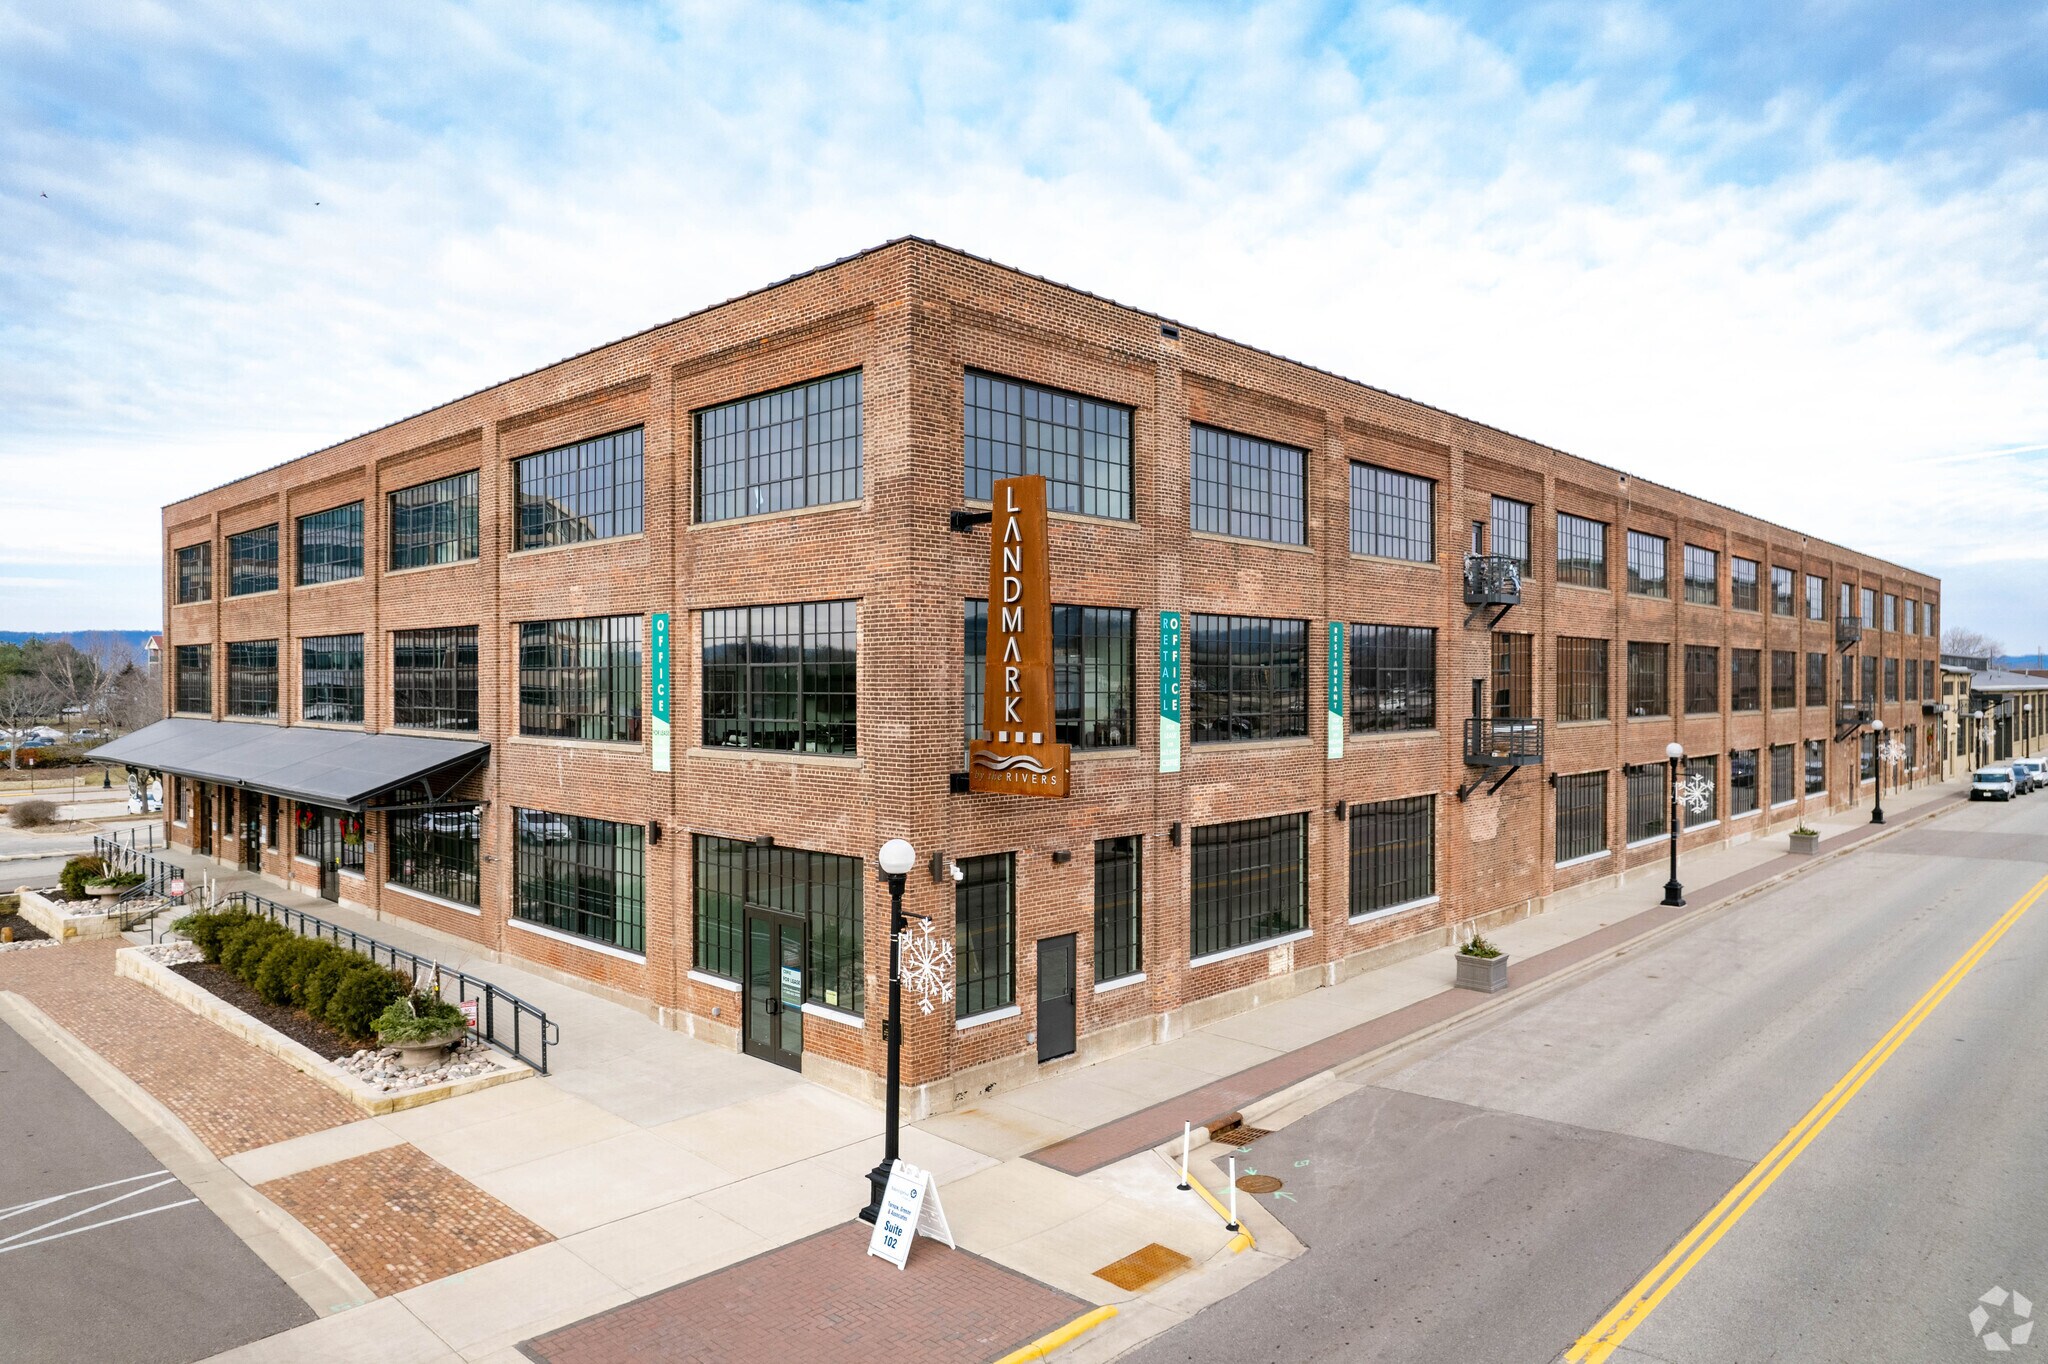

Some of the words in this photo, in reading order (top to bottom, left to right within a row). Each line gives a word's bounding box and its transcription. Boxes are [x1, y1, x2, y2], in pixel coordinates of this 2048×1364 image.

[1001, 486, 1023, 723] LANDMARK
[656, 619, 665, 712] OFFICE
[1169, 617, 1179, 711] OFFICE
[974, 770, 985, 780] by
[987, 771, 1003, 781] the
[1006, 772, 1057, 785] RIVERS
[883, 1235, 898, 1249] 102
[884, 1220, 903, 1237] Suite
